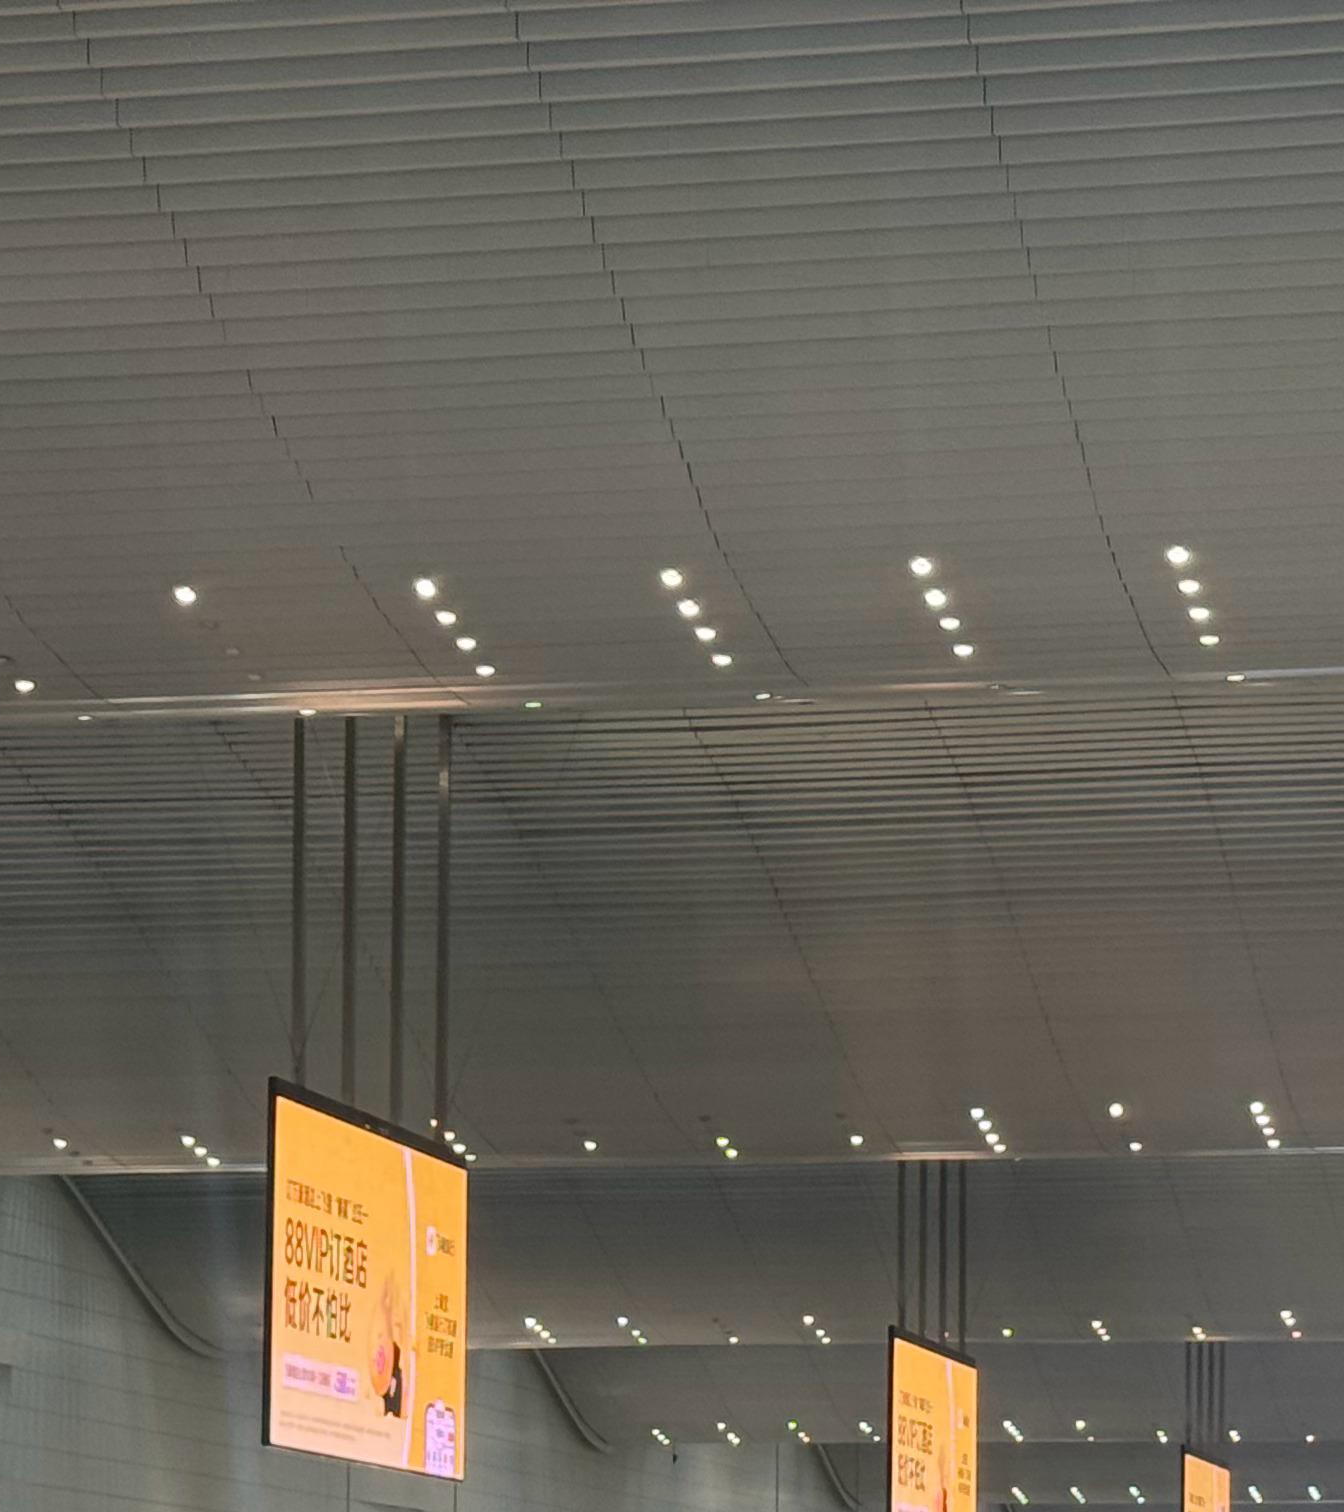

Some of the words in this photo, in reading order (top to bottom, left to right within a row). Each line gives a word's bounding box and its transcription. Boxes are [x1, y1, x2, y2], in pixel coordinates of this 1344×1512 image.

[284, 1217, 368, 1289] 88VIP订酒店
[284, 1276, 352, 1344] 低价不怕比
